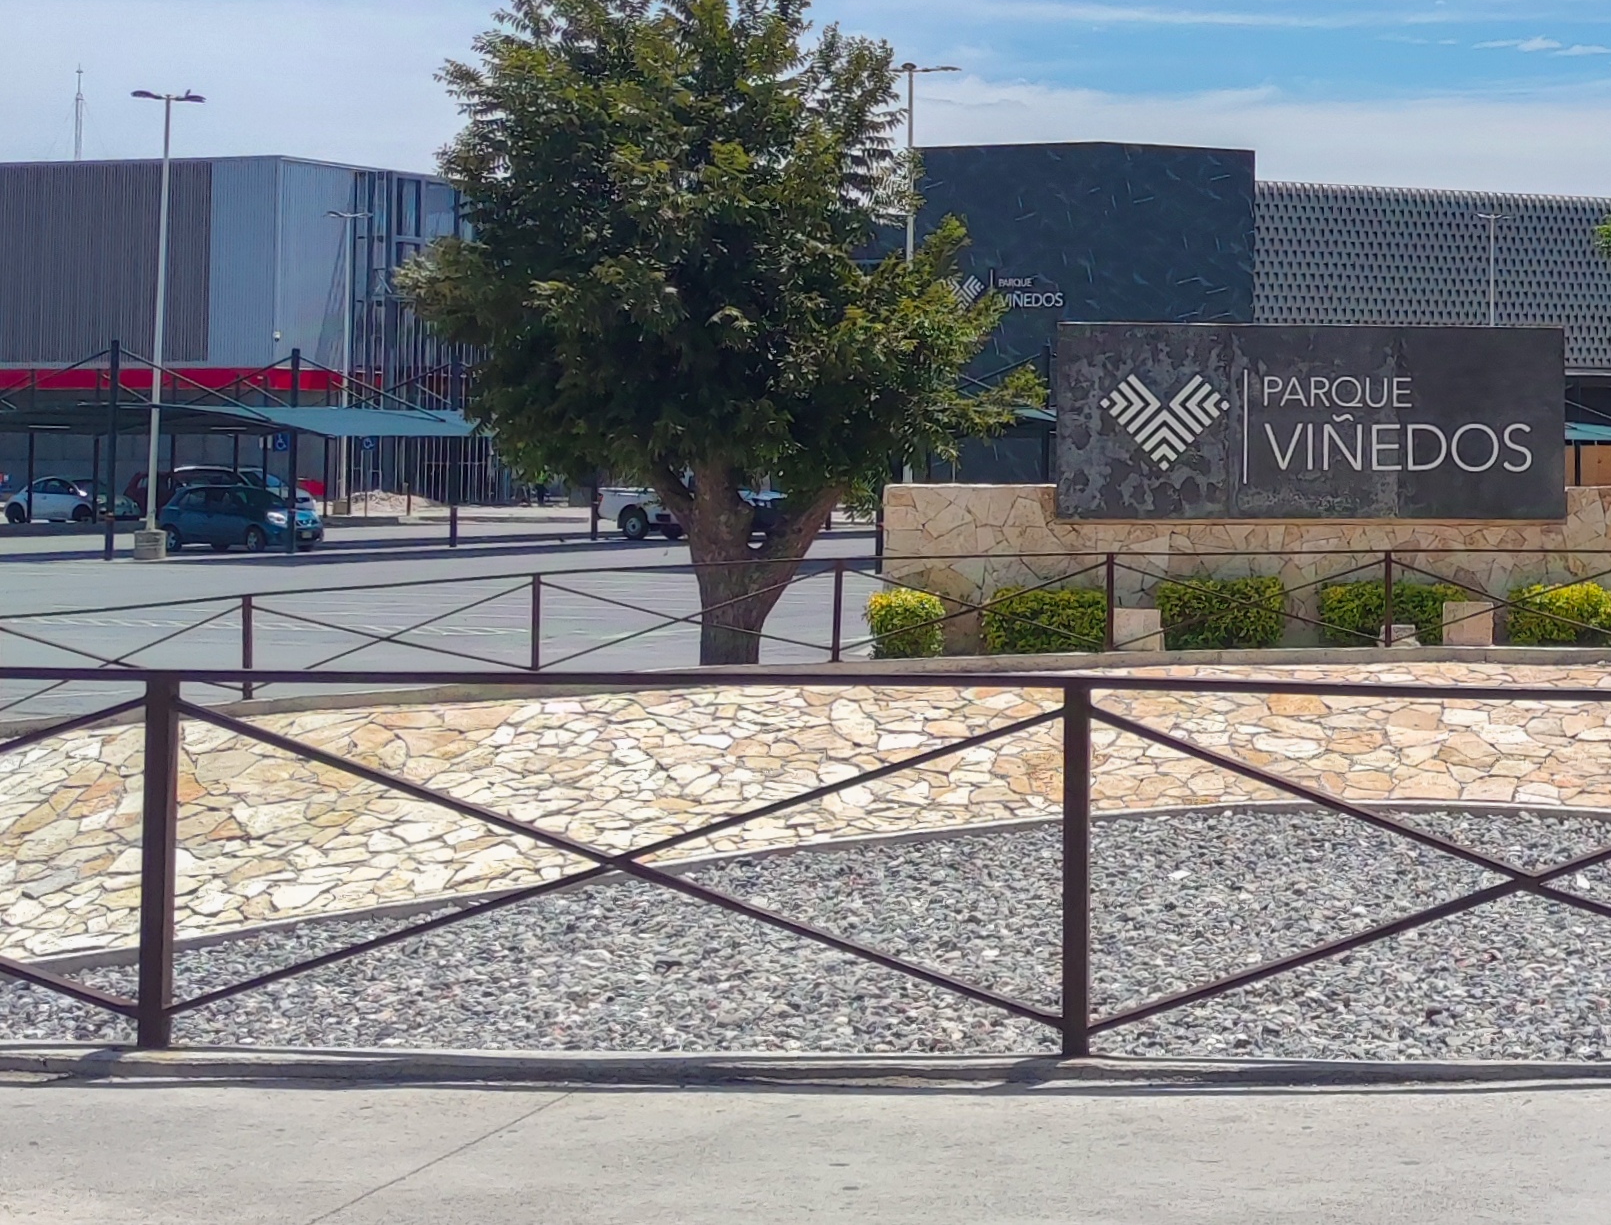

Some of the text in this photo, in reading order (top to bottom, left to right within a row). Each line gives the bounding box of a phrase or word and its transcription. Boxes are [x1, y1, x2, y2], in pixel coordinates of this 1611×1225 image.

[998, 278, 1033, 288] PARQUE
[1263, 376, 1413, 409] PARQUE
[1264, 412, 1534, 473] VIÑEDOS
